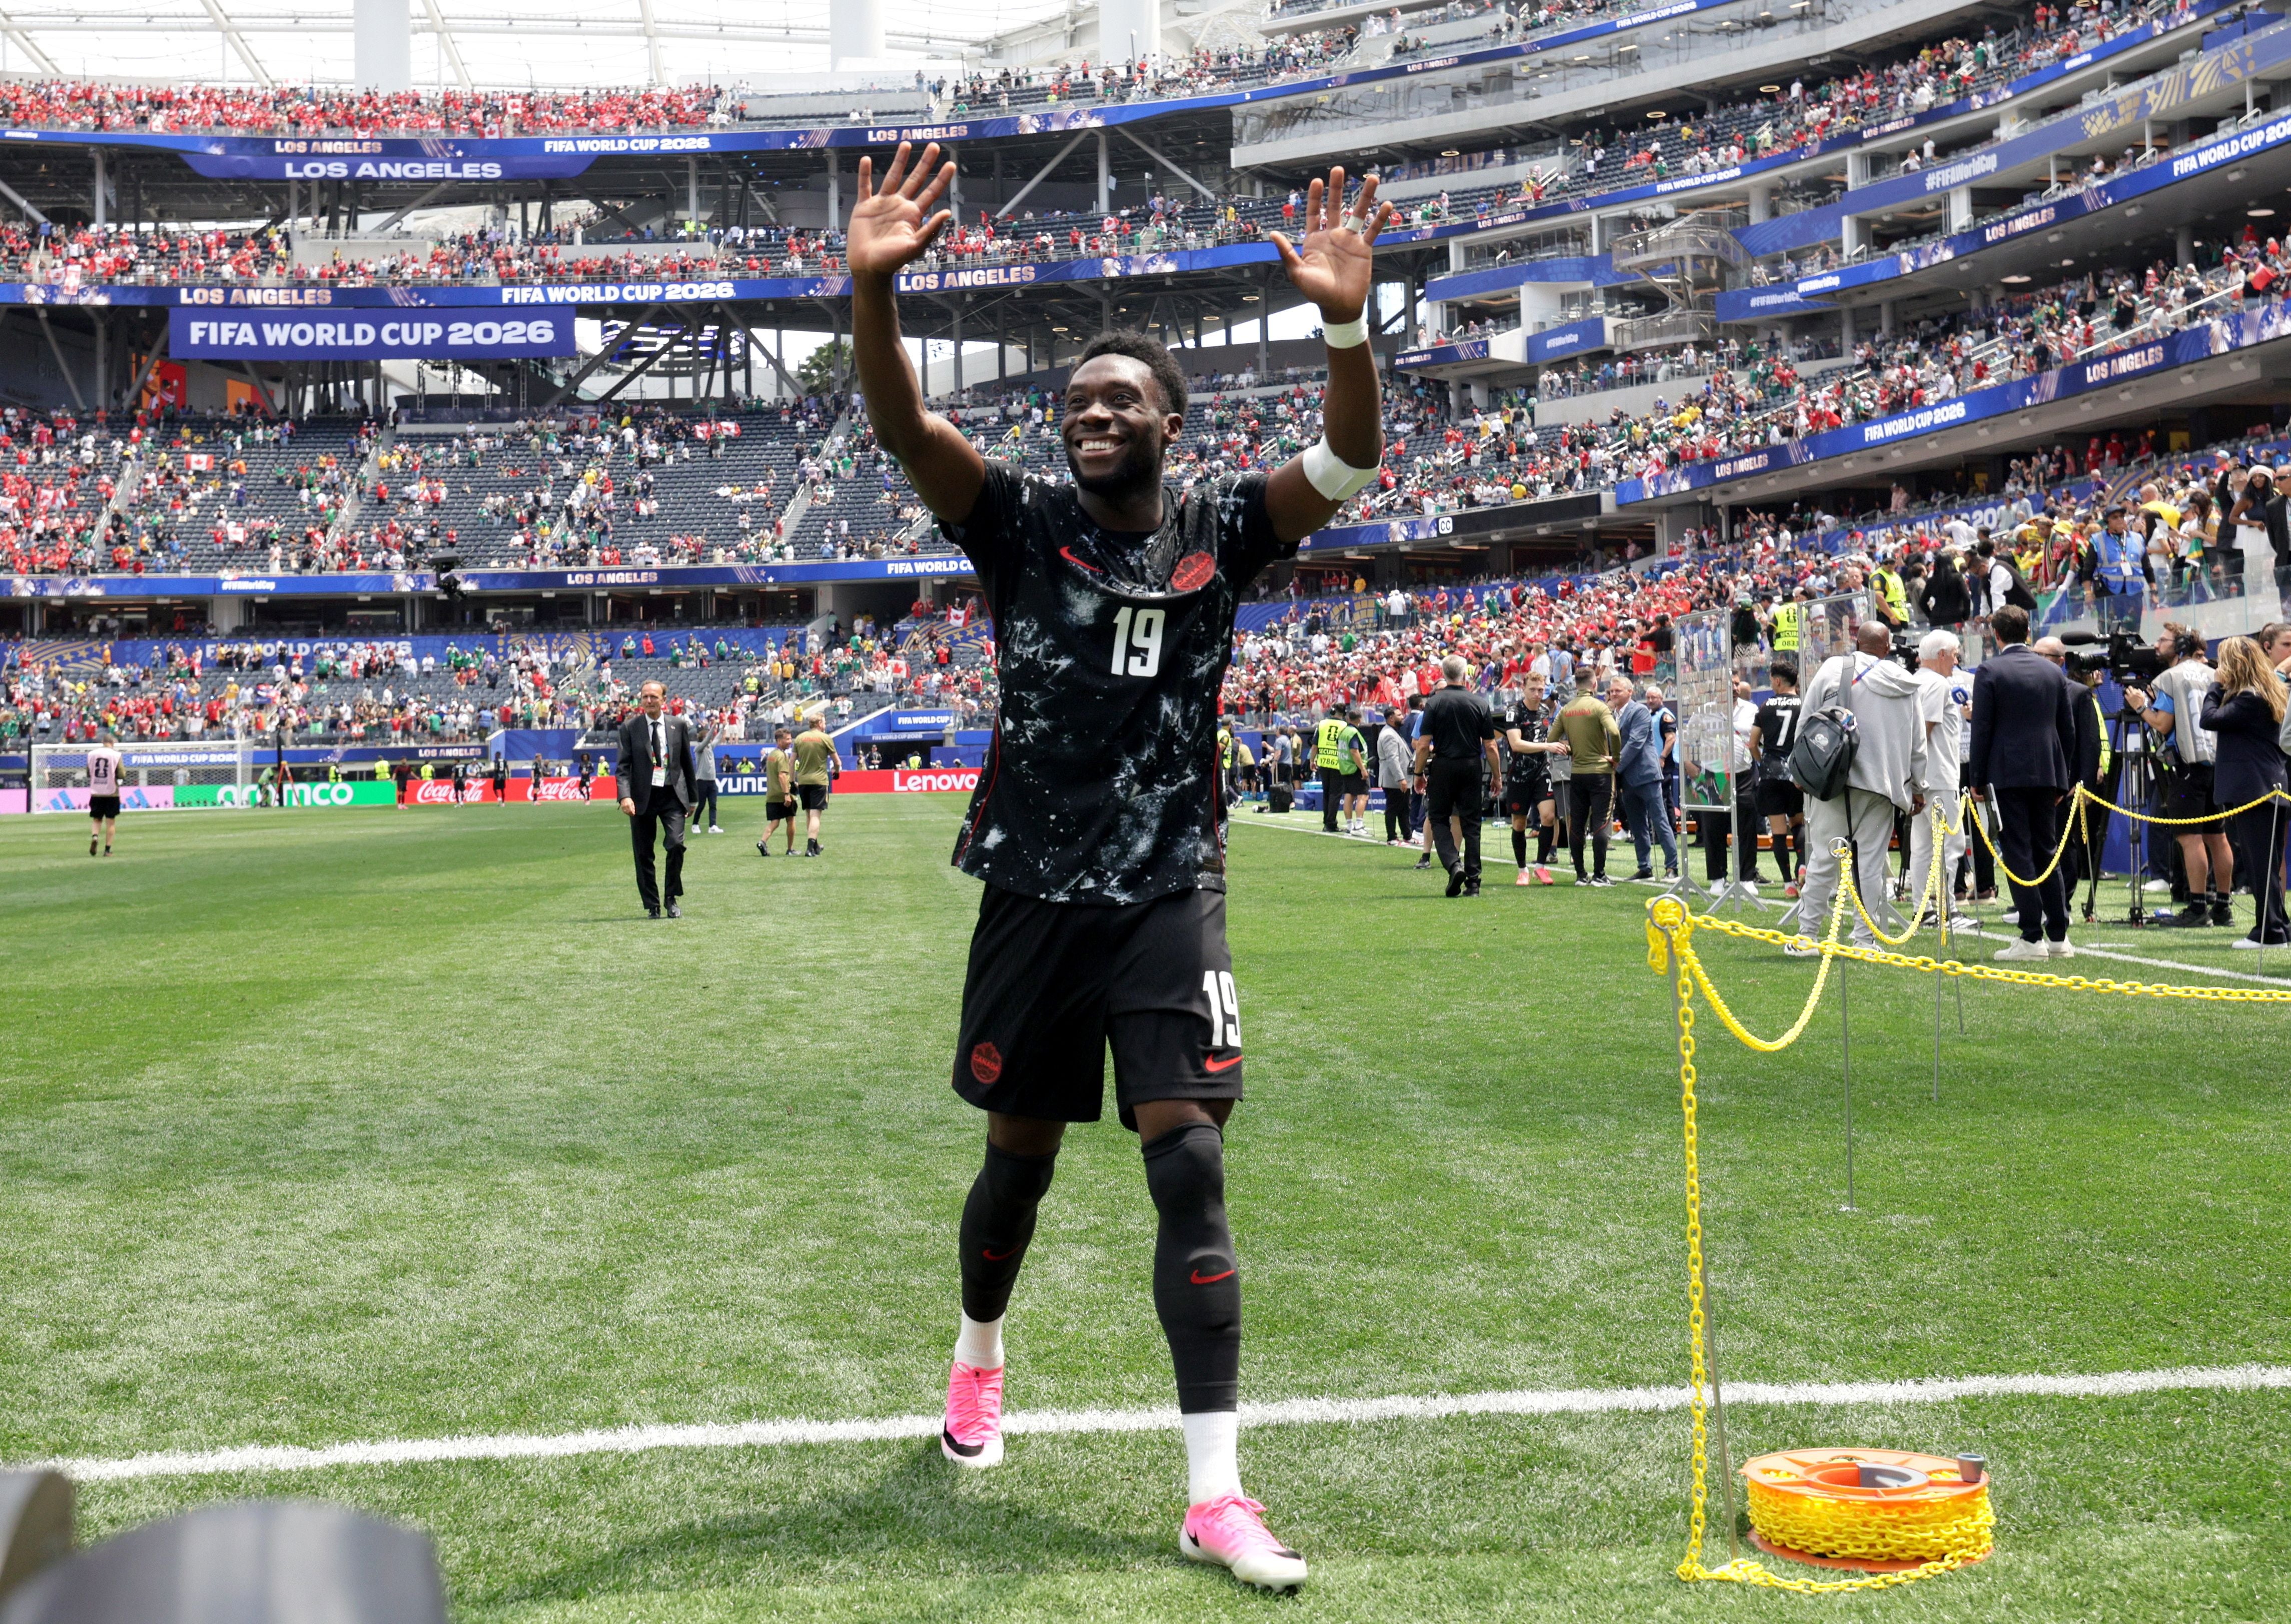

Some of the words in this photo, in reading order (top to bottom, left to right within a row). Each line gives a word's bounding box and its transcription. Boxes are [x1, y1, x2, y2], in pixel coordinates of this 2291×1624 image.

[1617, 18, 1632, 28] FIFA
[1632, 12, 1657, 25] WORLD
[1657, 8, 1671, 19] CUP
[1407, 63, 1422, 72] LOS
[1424, 58, 1458, 69] ANGELES
[868, 130, 898, 142] LOS
[901, 125, 968, 140] ANGELES
[1863, 127, 1878, 139] LOS
[1879, 117, 1914, 134] ANGELES
[275, 141, 307, 153] LOS
[311, 141, 382, 153] ANGELES
[544, 141, 575, 152] FIFA
[576, 139, 628, 151] WORLD
[629, 139, 659, 150] CUP
[660, 137, 710, 150] 2026
[2173, 154, 2198, 176] FIFA
[2197, 140, 2240, 167] WORLD
[2240, 130, 2265, 152] CUP
[285, 163, 348, 178] LOS
[355, 163, 501, 178] ANGELES
[1657, 182, 1674, 193] FIFA
[1673, 177, 1701, 190] WORLD
[1701, 173, 1717, 184] CUP
[1716, 168, 1741, 181] 2026
[1926, 153, 1997, 191] #FIFAWorldCup
[1477, 219, 1492, 229] LOS
[1493, 213, 1525, 225] ANGELES
[1986, 223, 2006, 242] LOS
[2007, 207, 2055, 235] ANGELES
[900, 273, 939, 291] LOS
[944, 266, 1035, 287] ANGELES
[180, 288, 225, 304] LOS
[230, 289, 332, 305] ANGELES
[502, 287, 541, 303] FIFA
[543, 286, 619, 302] WORLD
[622, 285, 662, 301] CUP
[665, 283, 734, 300] 2026
[190, 322, 257, 345] FIFA
[262, 322, 375, 345] WORLD
[381, 321, 443, 345] CUP
[448, 321, 554, 344] 2026
[2086, 361, 2108, 383] LOS
[2111, 346, 2163, 376] ANGELES
[1865, 424, 1884, 442] FIFA
[1884, 416, 1915, 438] WORLD
[1915, 411, 1933, 429] CUP
[1933, 402, 1966, 424] 2026
[1715, 462, 1731, 478] LOS
[1733, 453, 1768, 473] ANGELES
[1440, 520, 1450, 531] CC
[887, 562, 914, 574] FIFA
[915, 560, 958, 573] WORLD
[959, 560, 974, 571] CU
[567, 573, 593, 584] LOS
[596, 572, 657, 583] ANGELES
[1111, 607, 1165, 677] 19
[898, 717, 913, 725] FIFA
[912, 716, 937, 724] WORLD
[936, 715, 950, 723] CUP
[1776, 709, 1792, 746] 7
[155, 754, 189, 762] WORLD
[190, 754, 208, 762] CUP
[419, 749, 437, 757] LOS
[439, 748, 481, 756] ANGELES
[714, 776, 768, 793] YUND
[894, 771, 979, 791] Lenovo
[1546, 778, 1553, 792] 2
[416, 780, 487, 803] Cocala
[1202, 971, 1242, 1048] 19
